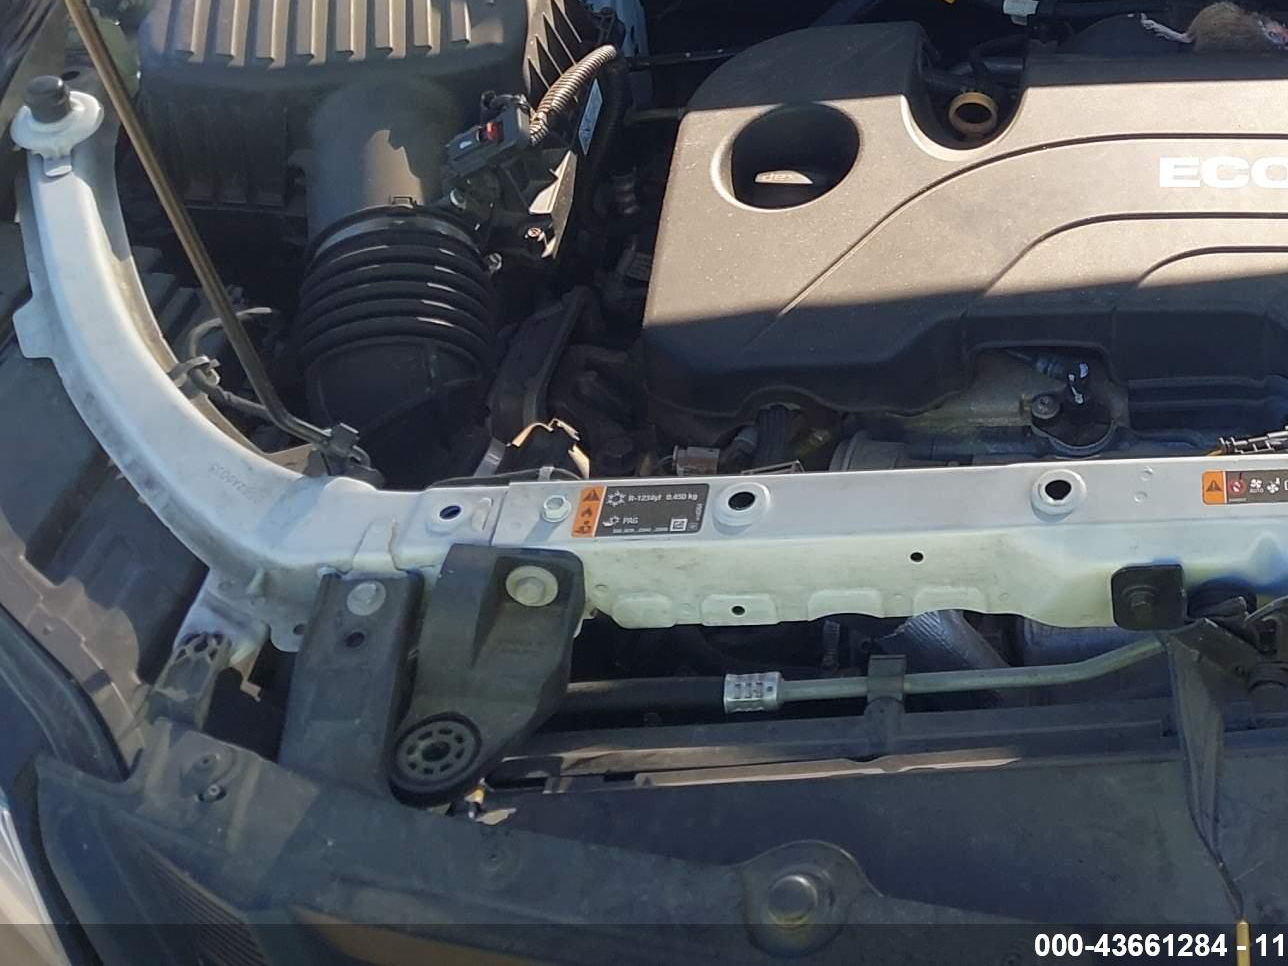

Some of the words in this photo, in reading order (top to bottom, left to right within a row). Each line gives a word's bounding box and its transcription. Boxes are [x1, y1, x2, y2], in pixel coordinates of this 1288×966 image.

[628, 494, 662, 503] R-1234yf
[665, 493, 687, 501] 0.450
[687, 493, 699, 501] kg
[622, 516, 639, 524] PAG
